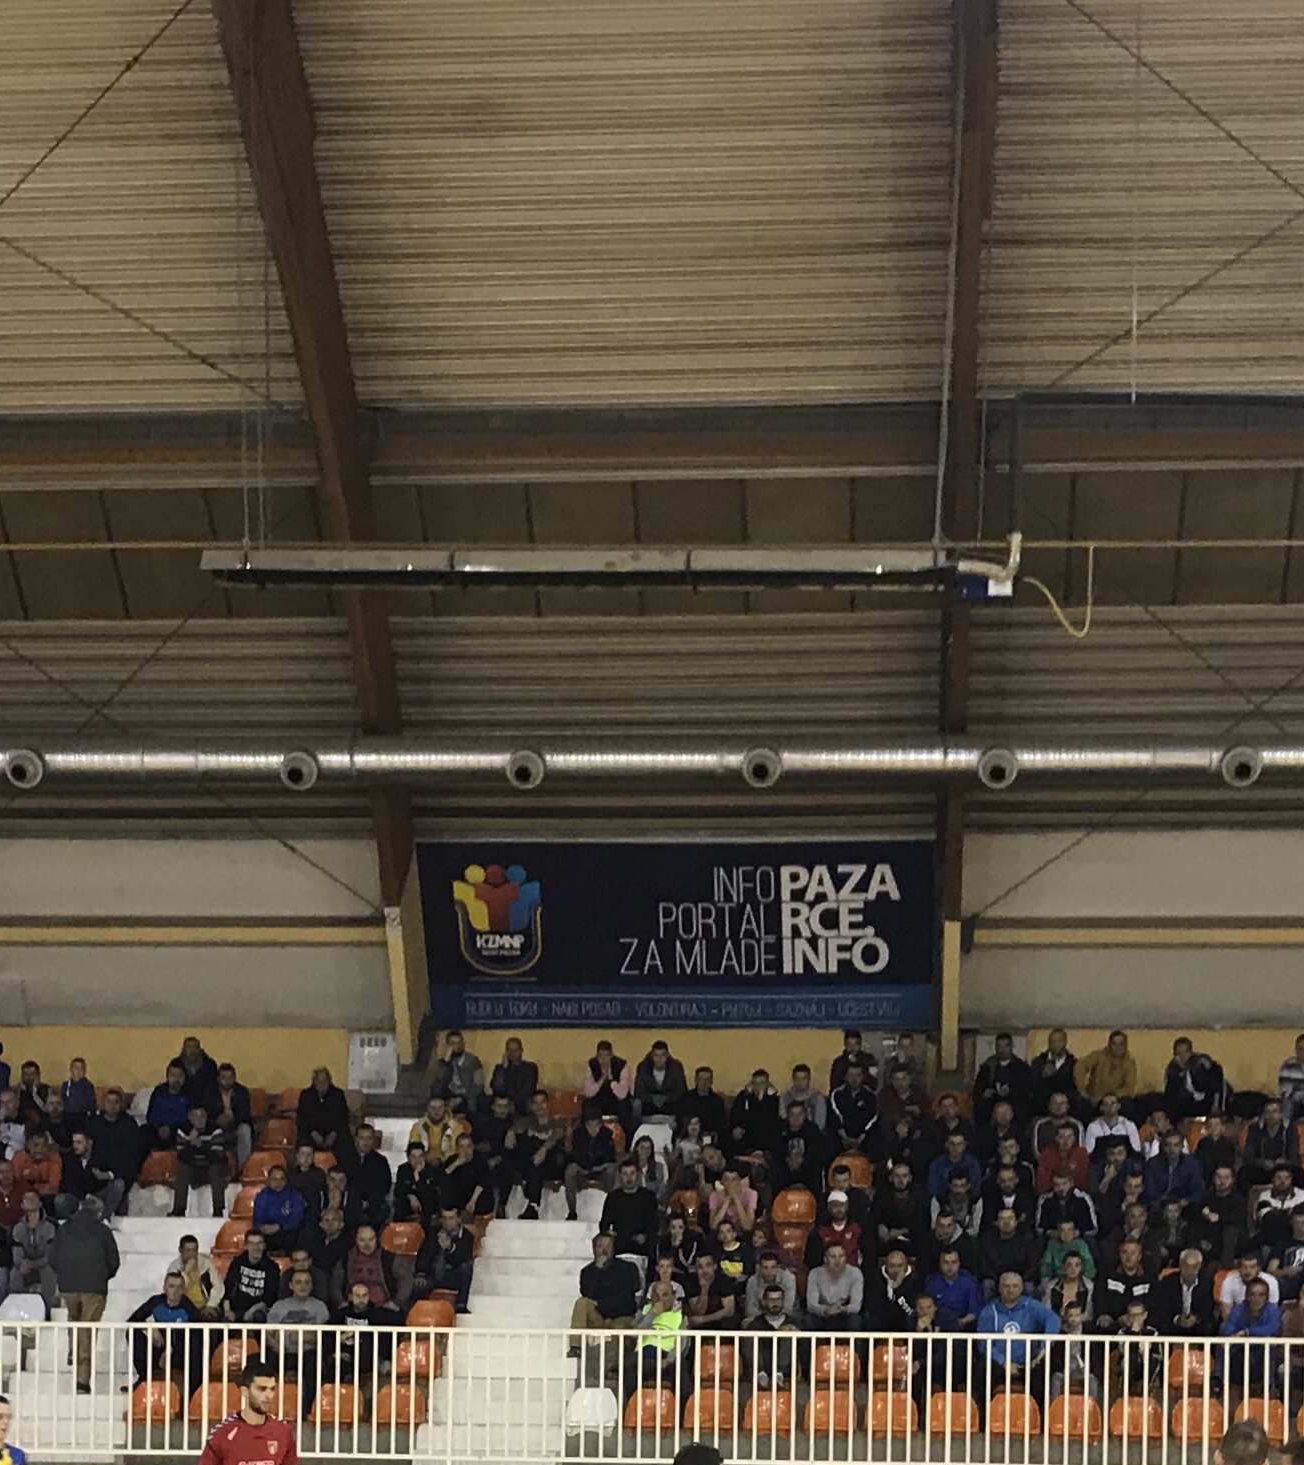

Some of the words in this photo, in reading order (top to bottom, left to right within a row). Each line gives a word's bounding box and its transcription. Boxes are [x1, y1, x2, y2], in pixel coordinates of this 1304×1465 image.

[713, 866, 775, 902] INFO
[780, 864, 901, 901] PAZA
[658, 902, 776, 938] PORTAL
[619, 938, 664, 975] ZA
[676, 938, 776, 975] MLADE
[782, 937, 890, 974] INFO
